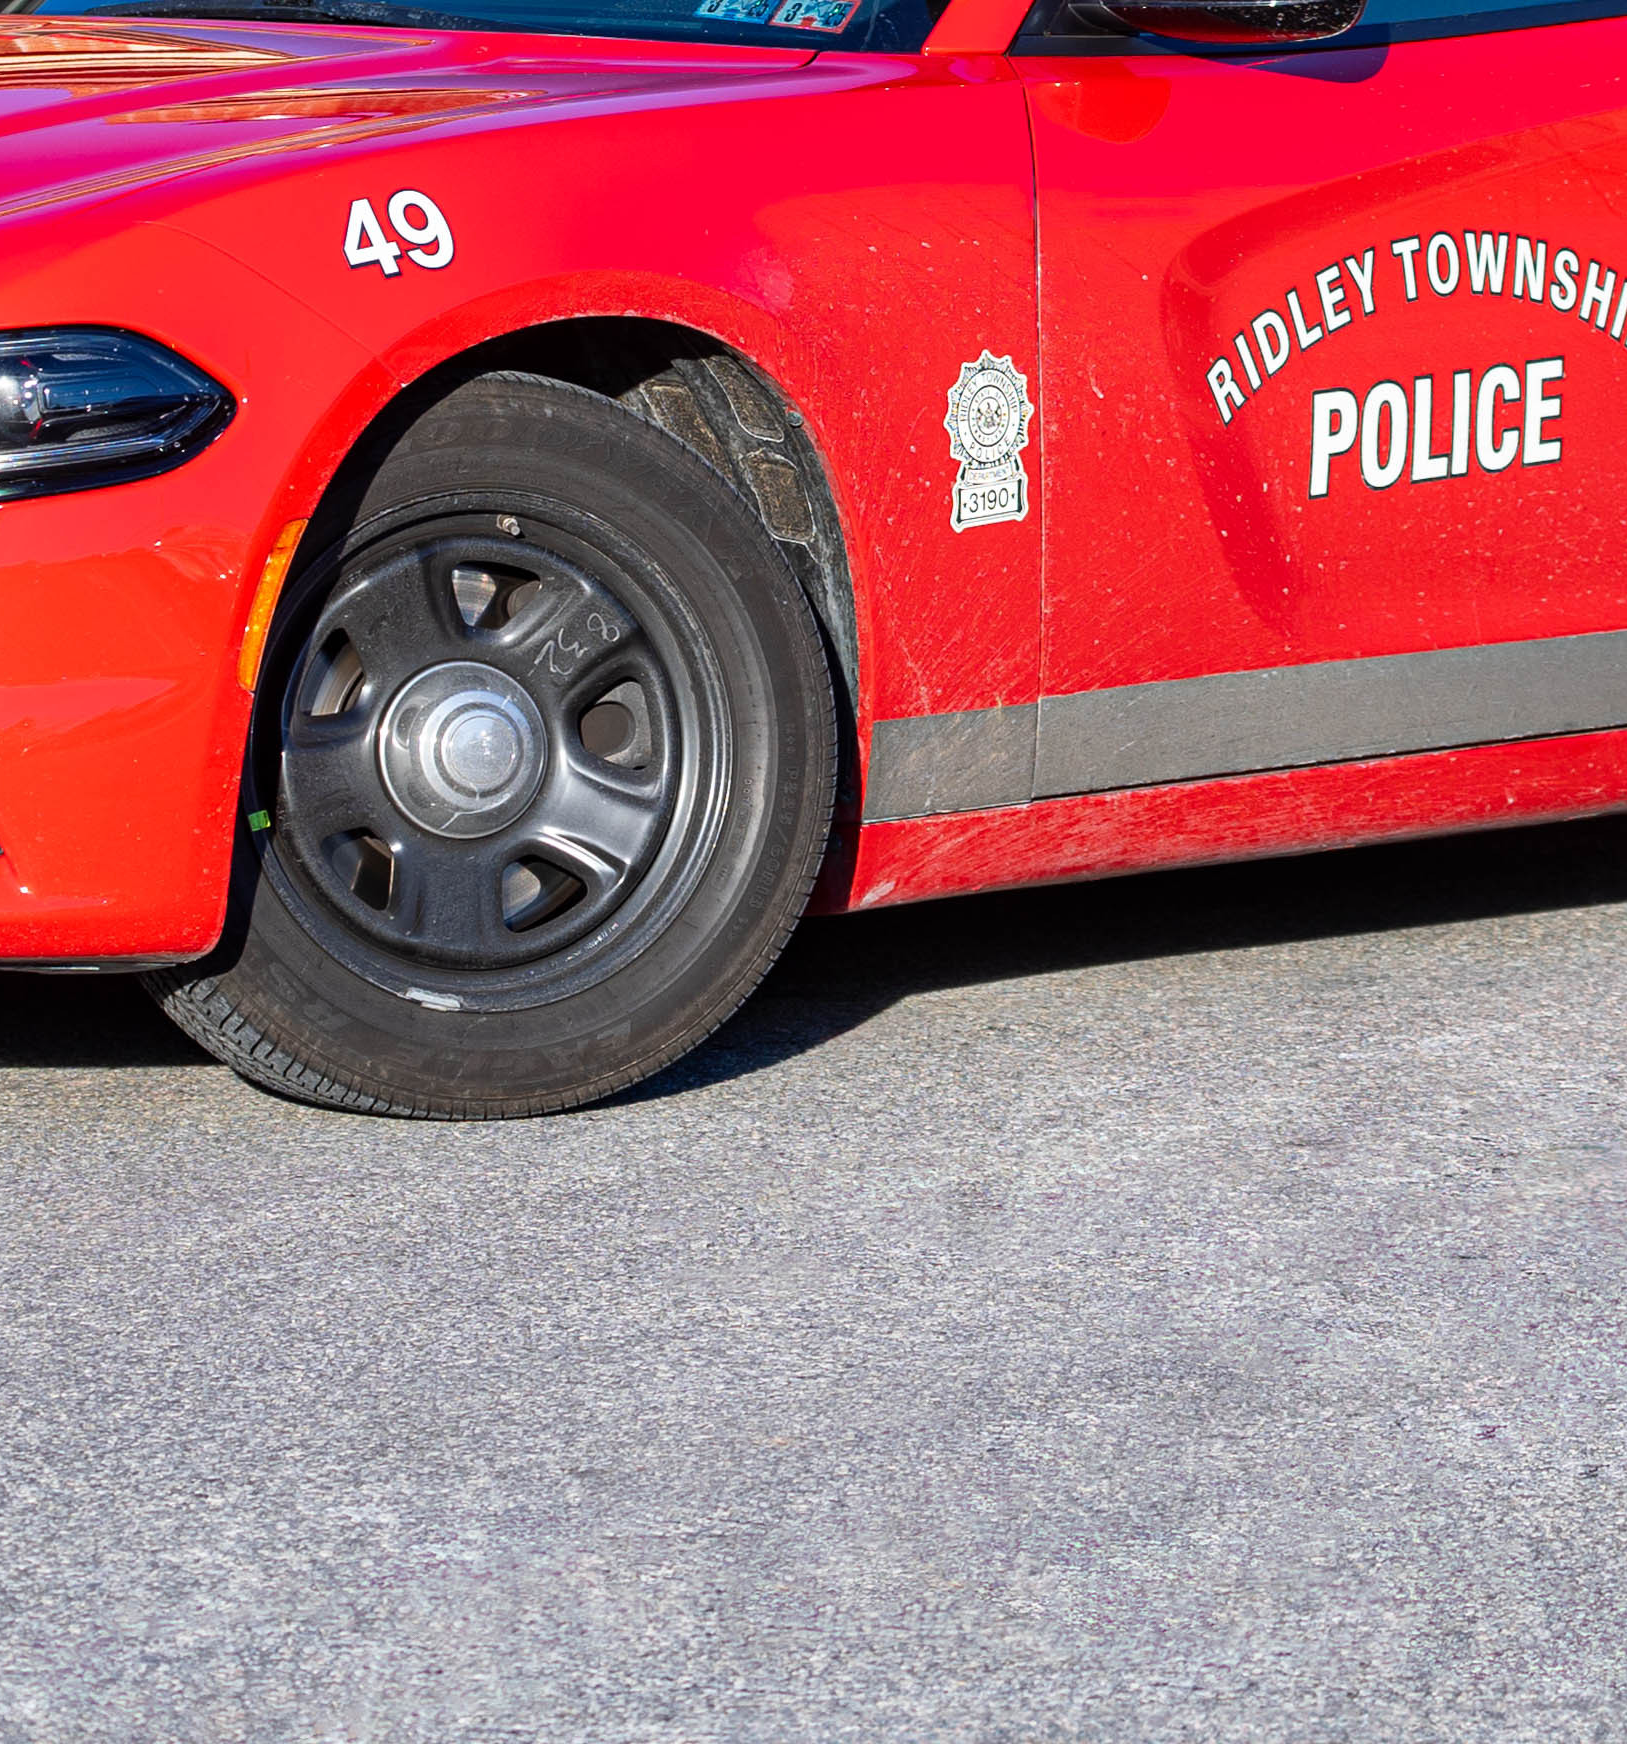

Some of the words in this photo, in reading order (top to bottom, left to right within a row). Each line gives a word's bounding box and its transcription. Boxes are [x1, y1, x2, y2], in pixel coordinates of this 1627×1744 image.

[783, 2, 802, 23] 3
[342, 188, 455, 279] 49
[1206, 246, 1378, 425] RIDLEY
[959, 379, 978, 422] RIDLEY
[981, 371, 1019, 413] TOWNSHIP
[969, 436, 1011, 460] POLICE
[1308, 356, 1566, 500] POLICE
[969, 487, 1009, 513] 3190
